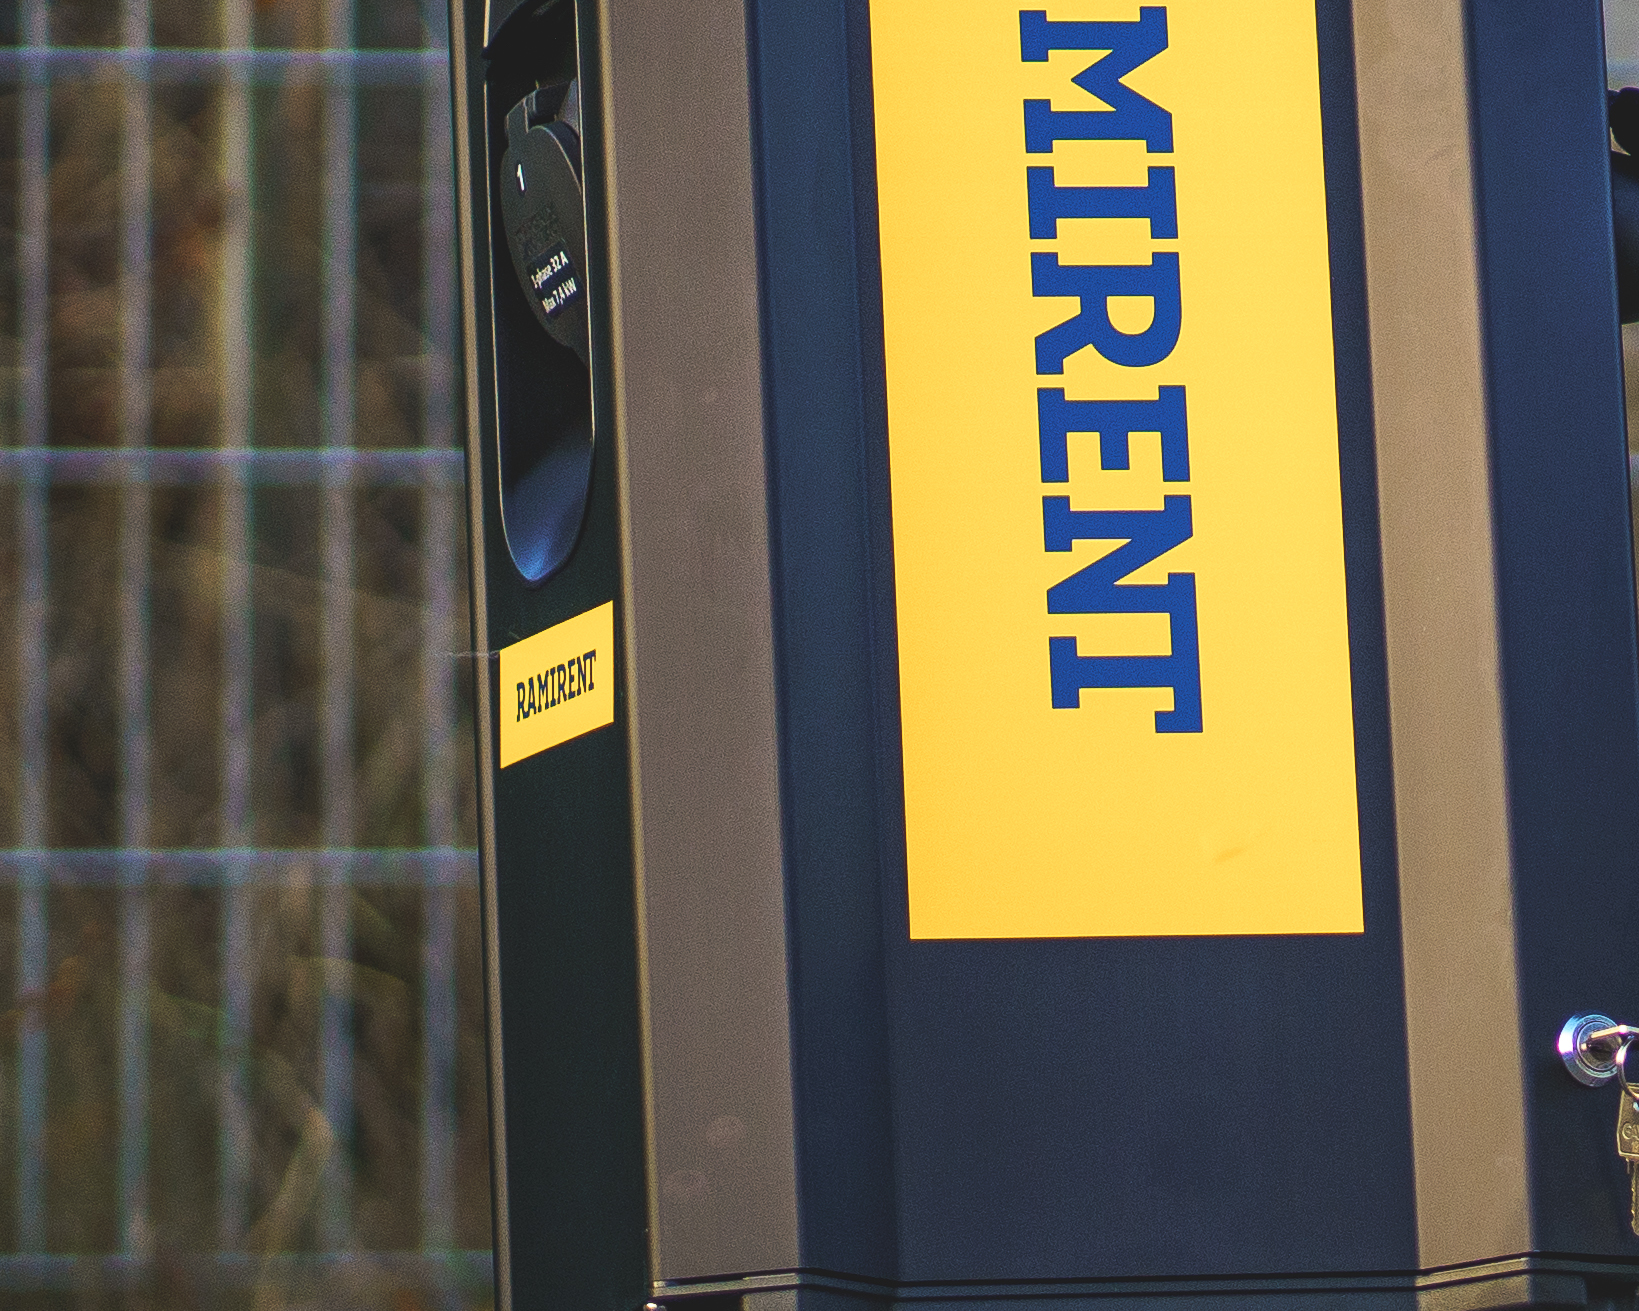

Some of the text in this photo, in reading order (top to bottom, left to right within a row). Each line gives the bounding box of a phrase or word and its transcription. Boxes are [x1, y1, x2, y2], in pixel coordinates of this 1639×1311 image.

[516, 163, 525, 191] 1
[550, 255, 562, 273] 32
[560, 251, 569, 266] A
[562, 277, 577, 297] kW
[516, 649, 597, 722] RAMIRENT
